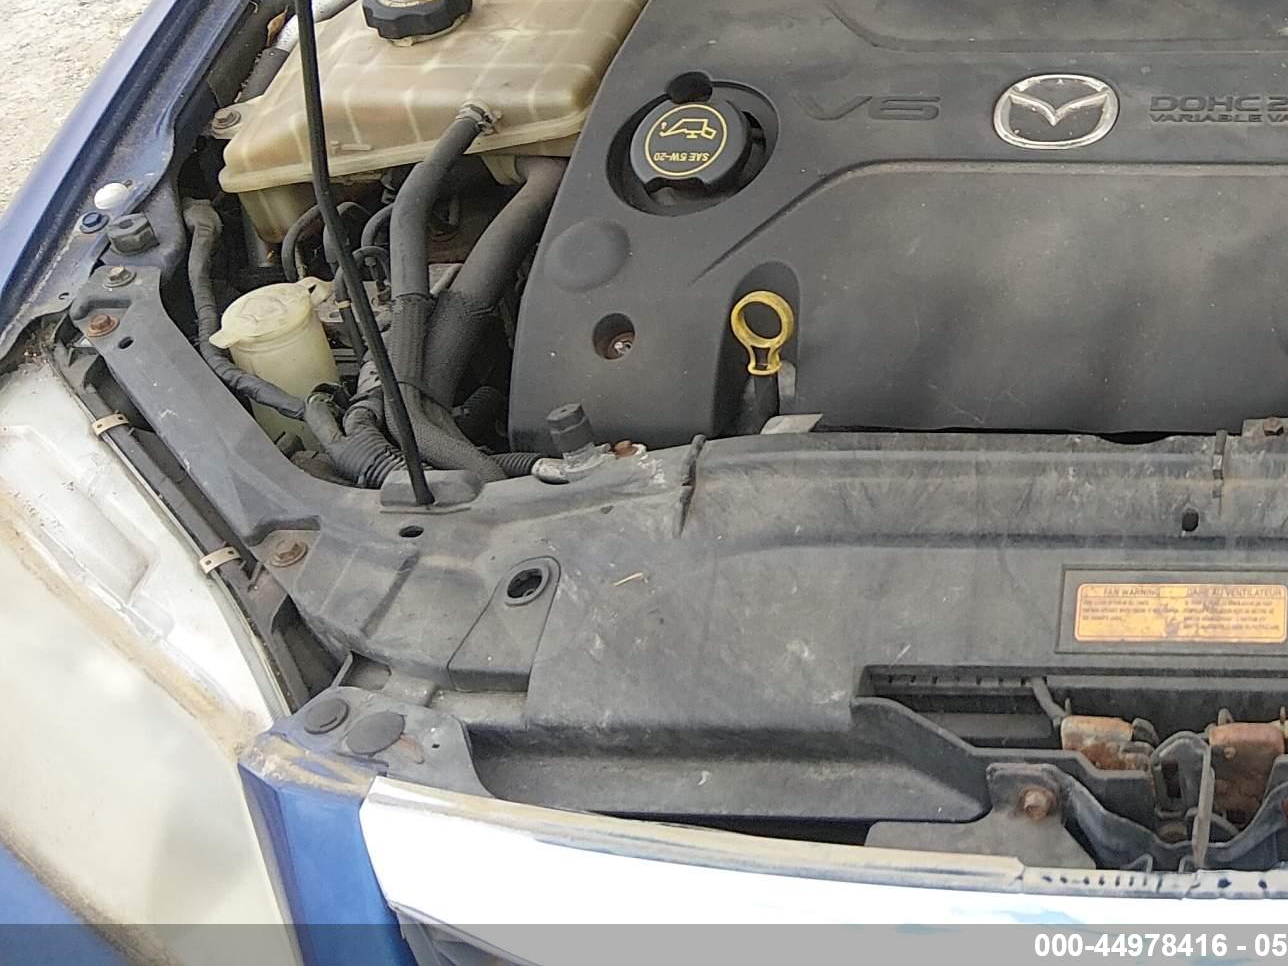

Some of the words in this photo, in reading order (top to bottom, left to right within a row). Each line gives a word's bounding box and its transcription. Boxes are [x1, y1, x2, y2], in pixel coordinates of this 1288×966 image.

[791, 95, 941, 121] V6
[1150, 96, 1261, 112] DOHC
[1150, 114, 1262, 123] VARIABLE
[653, 152, 688, 162] 5W-20
[688, 152, 711, 162] SAE
